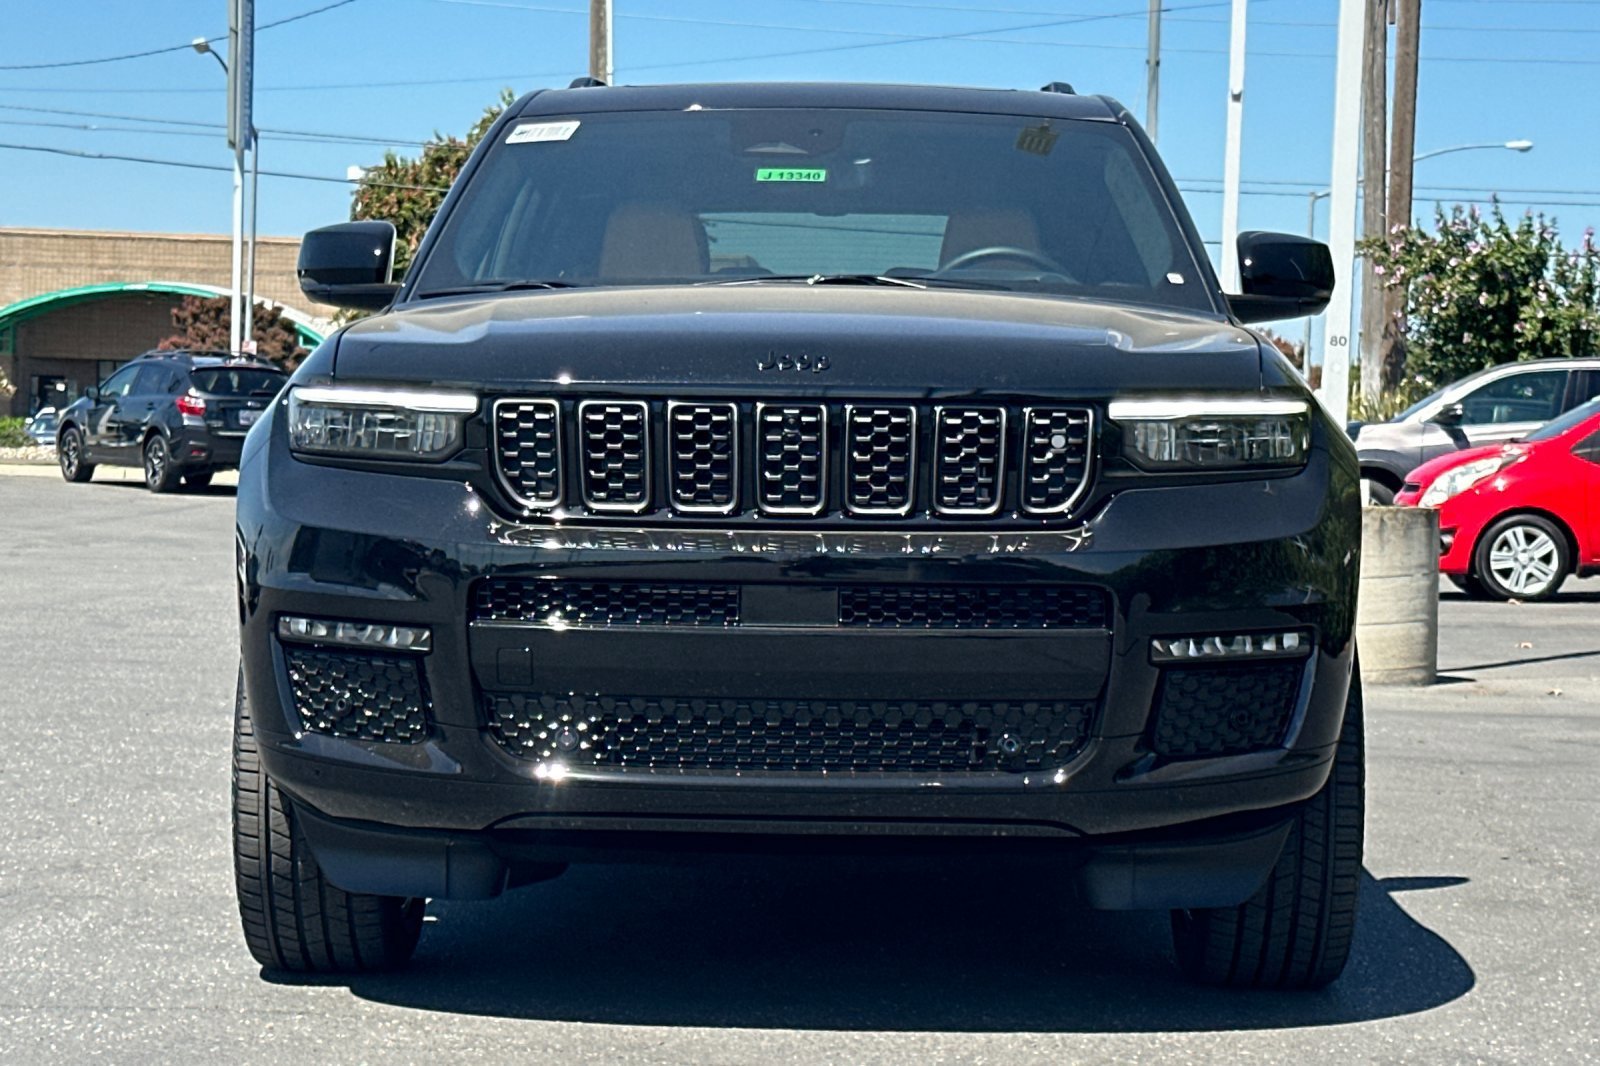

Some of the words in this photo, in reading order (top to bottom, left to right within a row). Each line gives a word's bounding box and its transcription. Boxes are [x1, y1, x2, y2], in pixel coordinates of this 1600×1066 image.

[763, 171, 772, 180] J
[778, 171, 821, 180] 13340
[1329, 335, 1347, 347] 80
[756, 350, 830, 373] Jeep
